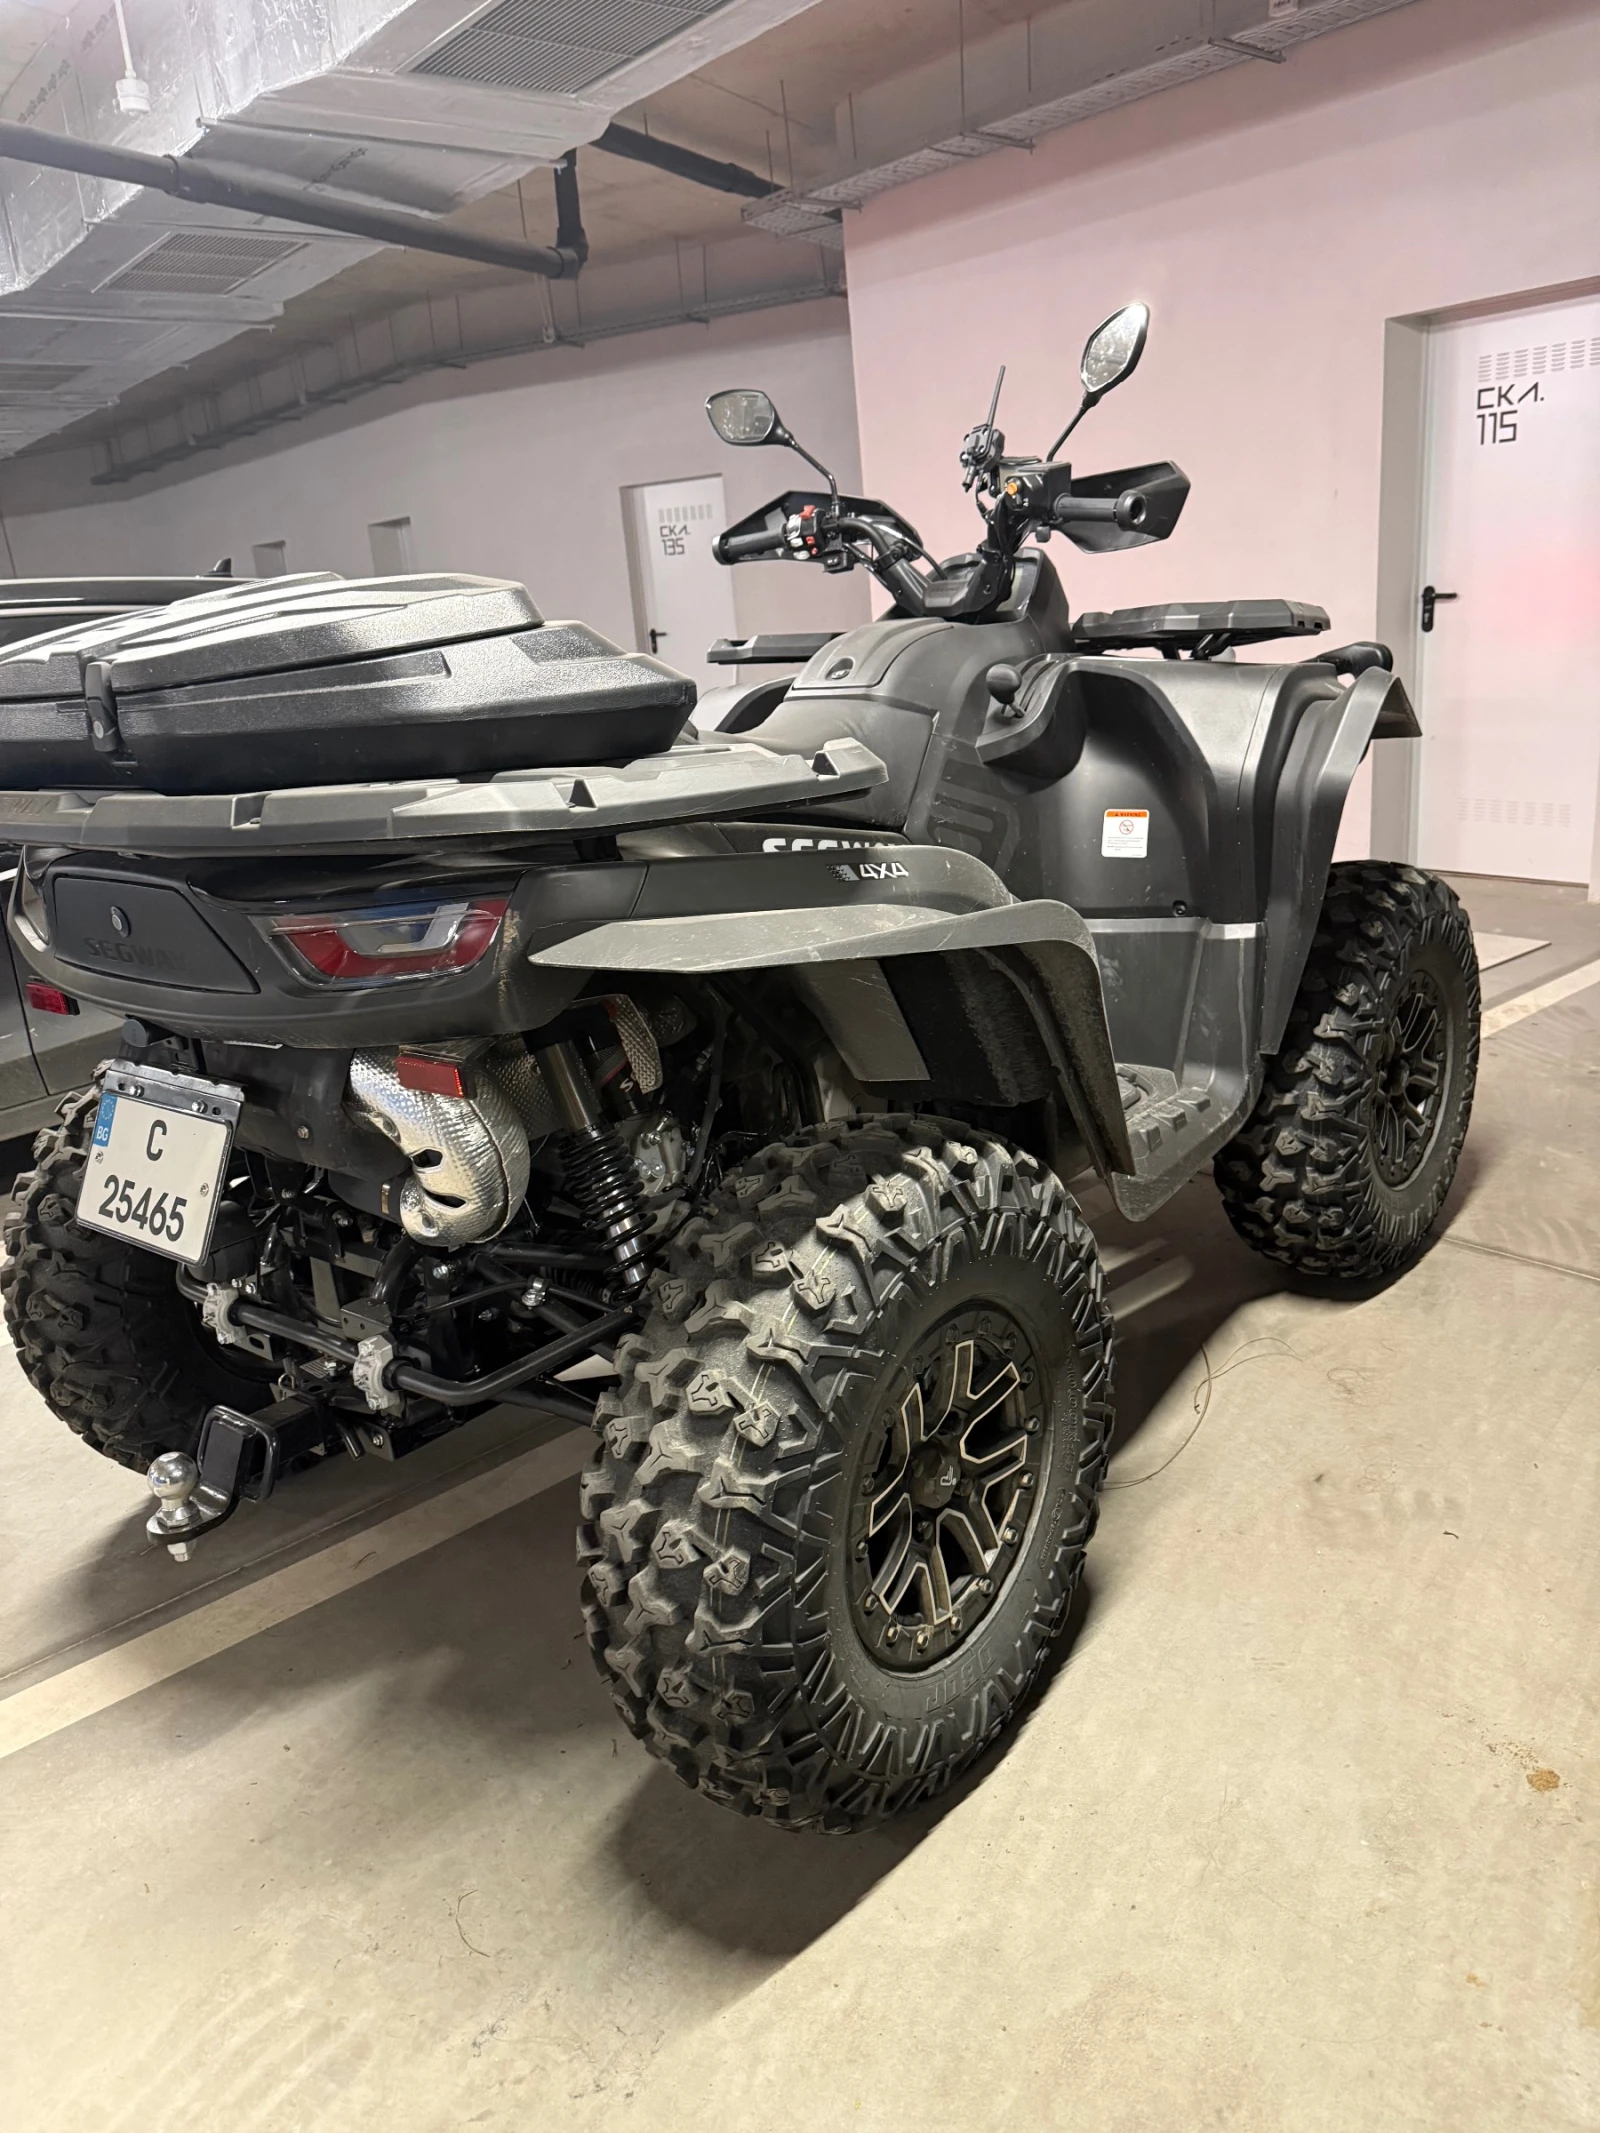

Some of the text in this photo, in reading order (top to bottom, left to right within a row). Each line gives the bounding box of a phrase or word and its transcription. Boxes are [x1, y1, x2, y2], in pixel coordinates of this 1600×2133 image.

[1476, 410, 1518, 445] 115
[661, 537, 685, 556] 135
[83, 937, 187, 973] SEGWAY
[96, 1125, 109, 1142] BG
[146, 1119, 168, 1162] C
[98, 1174, 188, 1242] 25465
